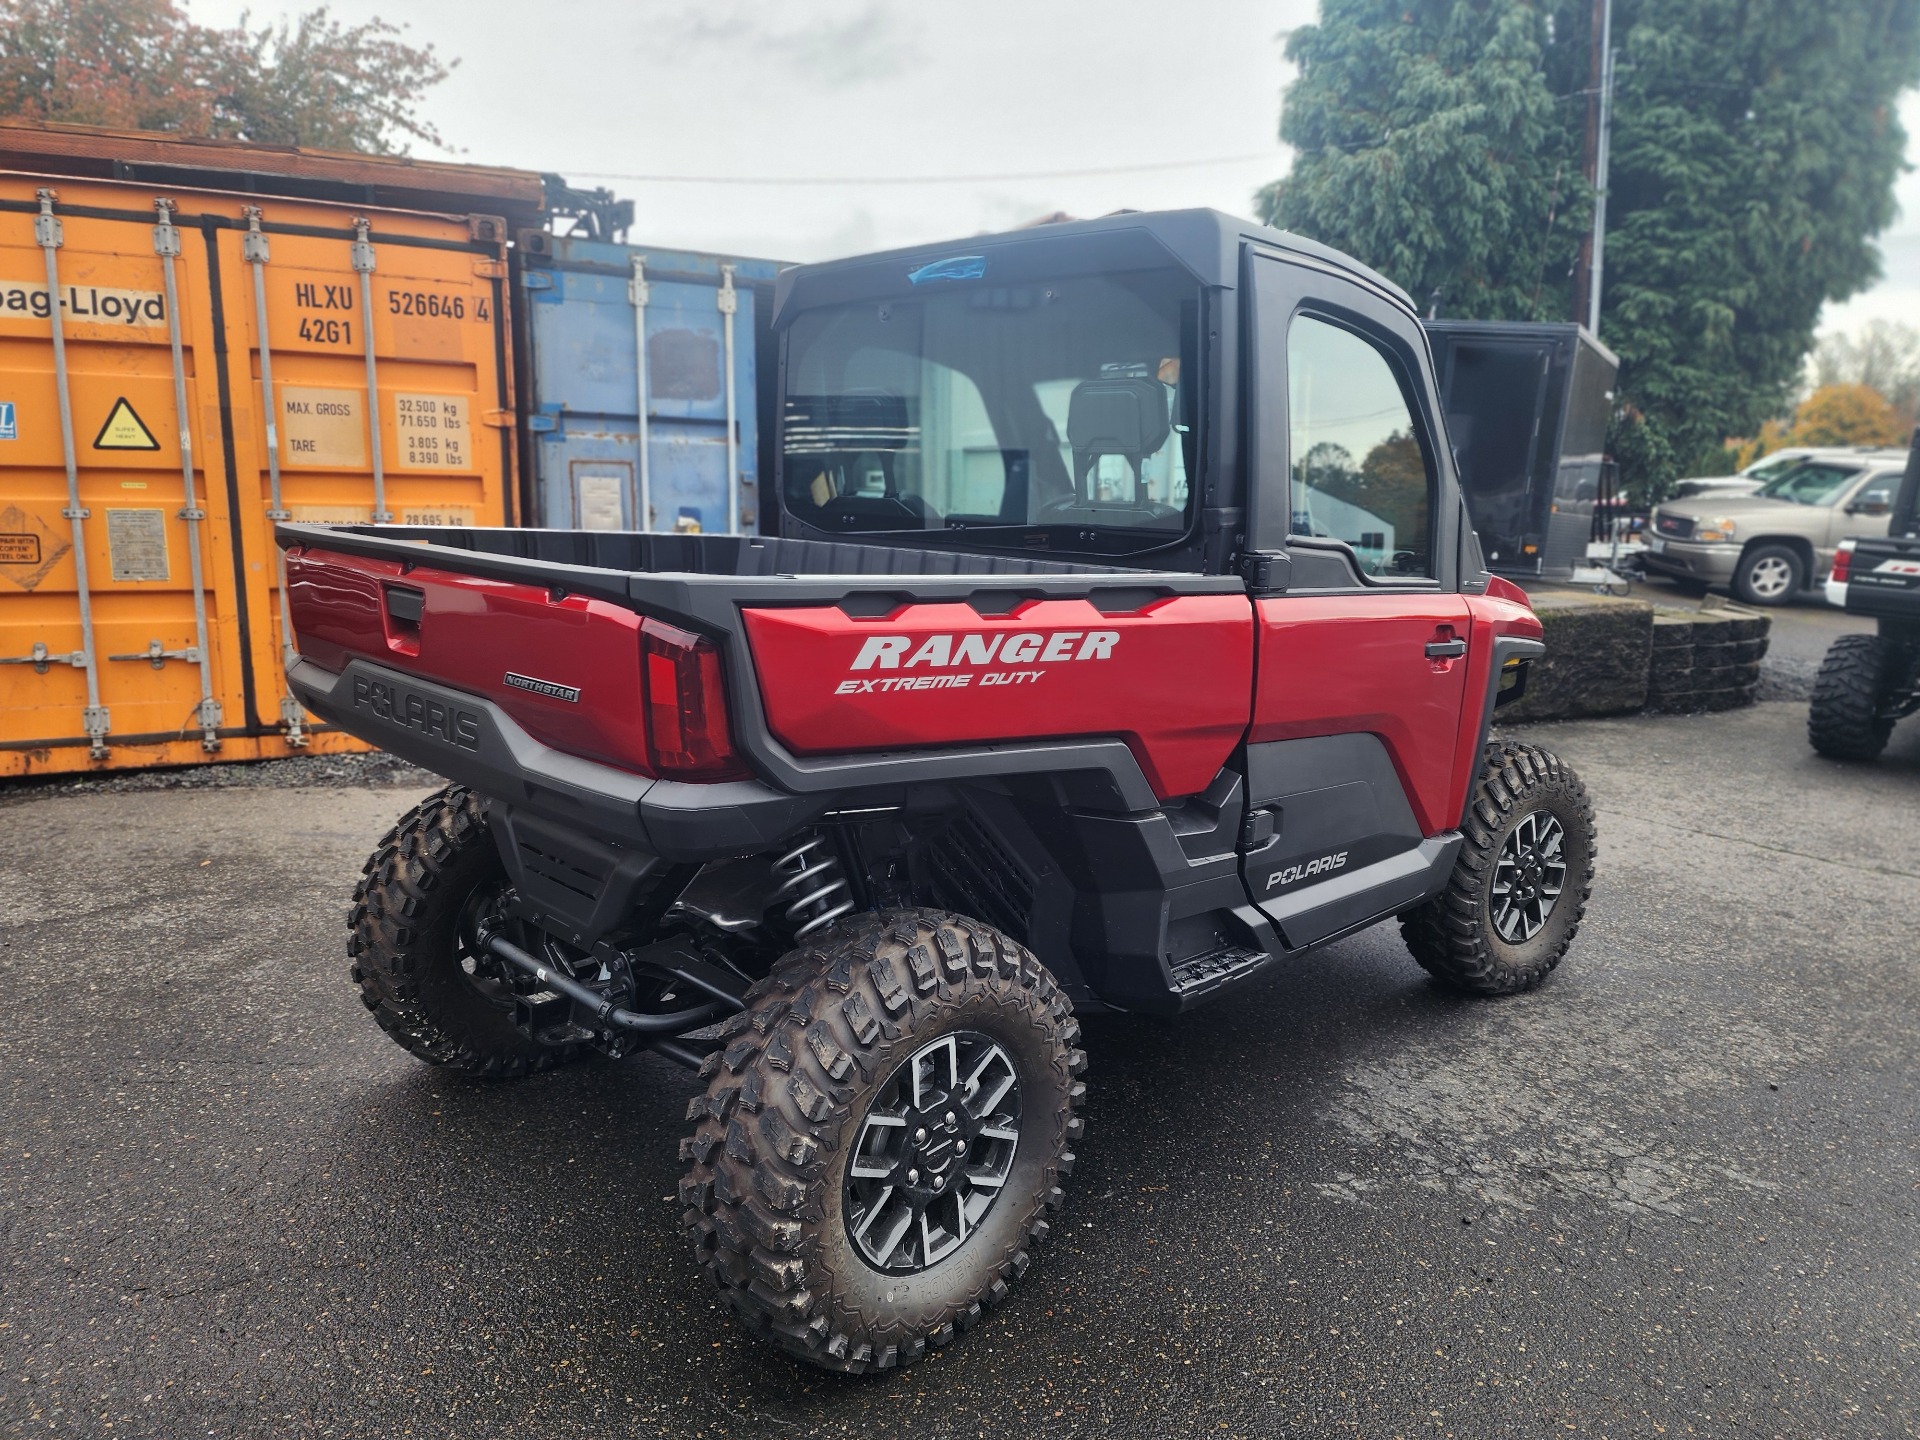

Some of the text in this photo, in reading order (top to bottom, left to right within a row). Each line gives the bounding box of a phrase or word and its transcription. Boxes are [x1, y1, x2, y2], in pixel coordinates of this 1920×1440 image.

[0, 287, 165, 324] ag-Lloyd
[296, 283, 489, 321] HLXU 526646 4
[299, 318, 351, 345] 42G1
[286, 402, 351, 416] MAX. GROSS
[399, 400, 457, 416] 32.500 kg
[400, 414, 461, 429] 71.650 lbs
[290, 439, 317, 452] TARE
[408, 436, 459, 452] 3.805 kg
[409, 452, 463, 465] 8.390 lbs
[406, 514, 442, 527] 28.695
[849, 631, 1121, 671] RANGER
[505, 674, 577, 701] NORTHSTAR
[834, 670, 1047, 695] EXTREME DUTY
[353, 674, 480, 752] POLARIS
[1265, 851, 1349, 890] POLARIS
